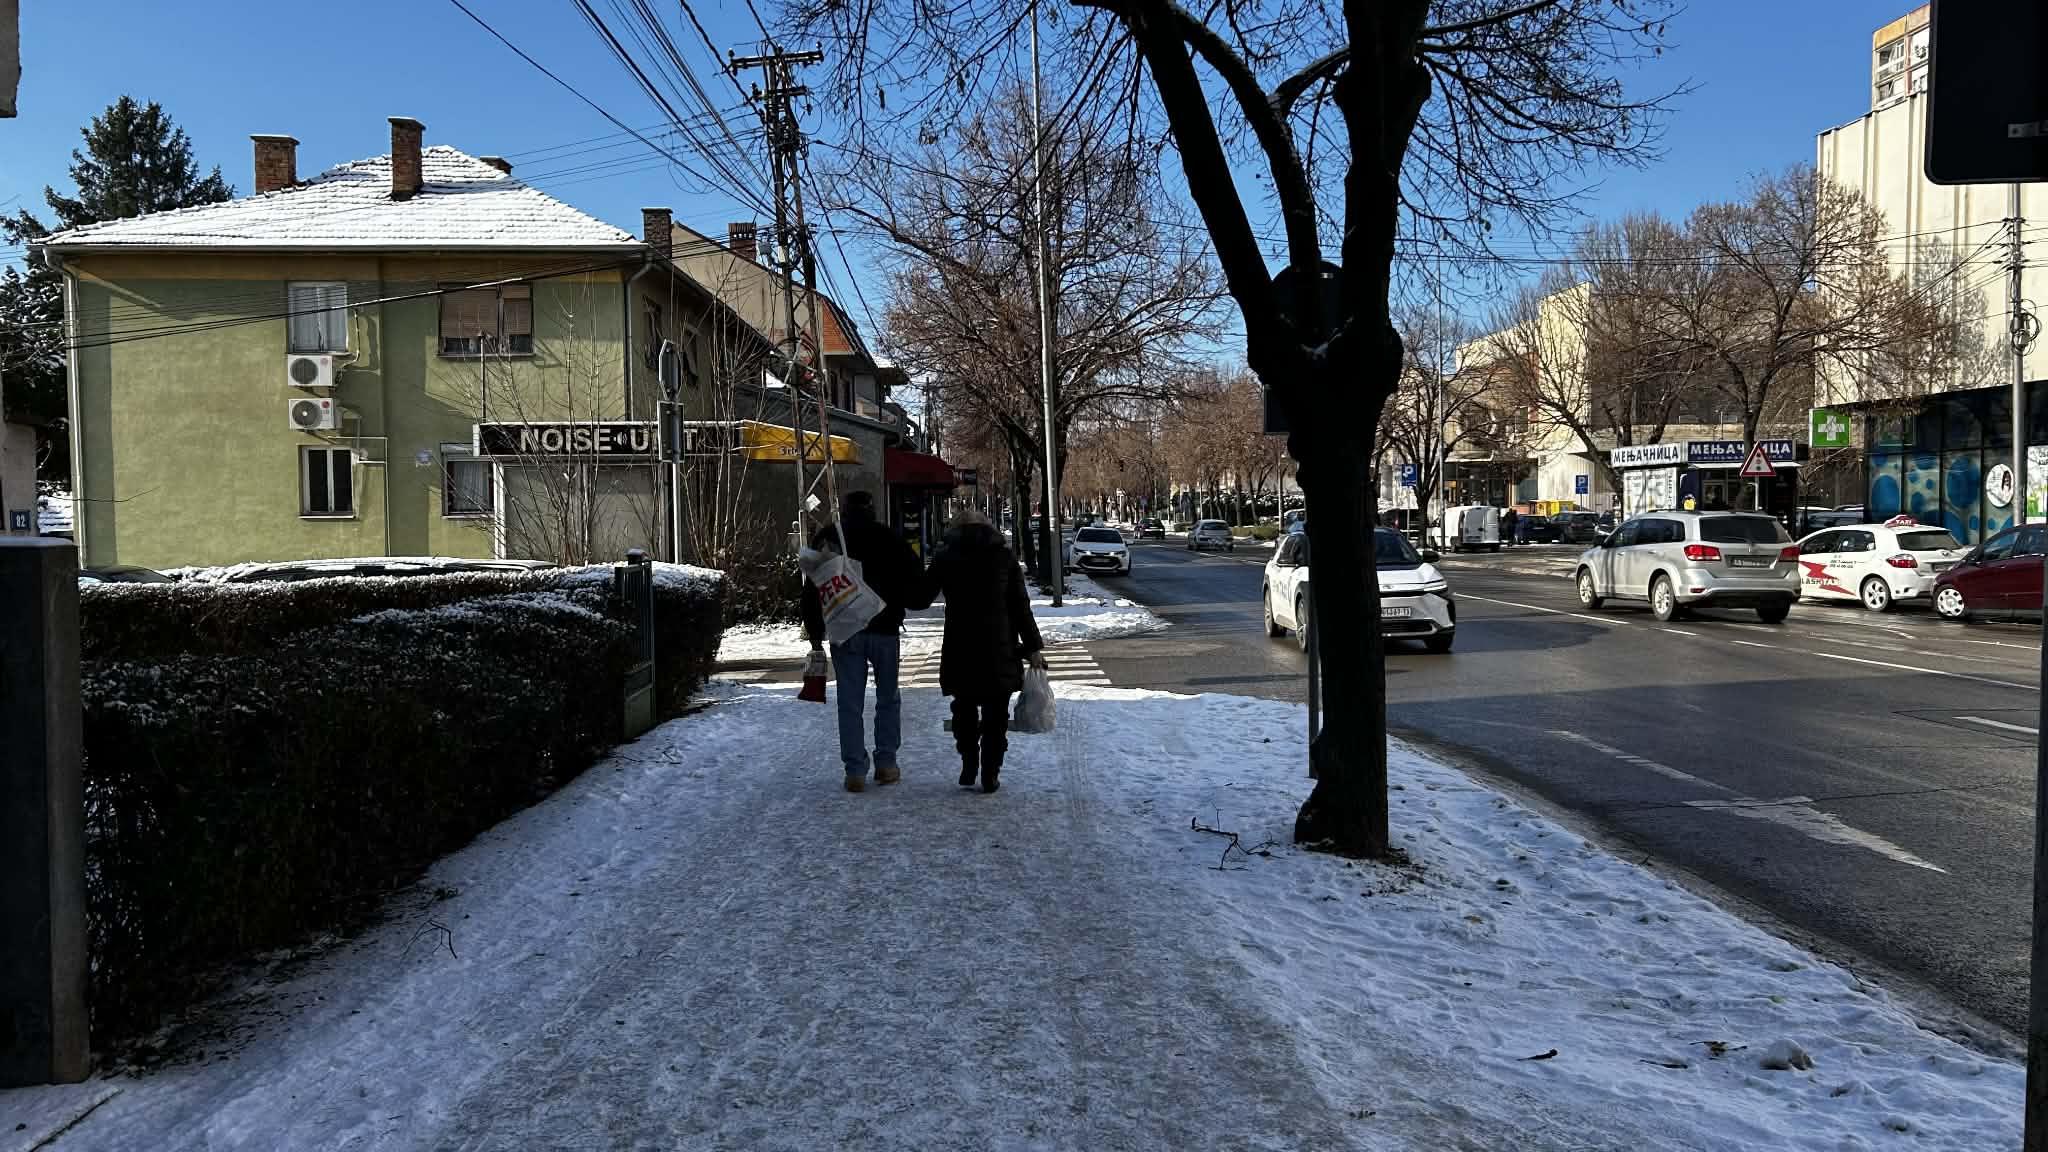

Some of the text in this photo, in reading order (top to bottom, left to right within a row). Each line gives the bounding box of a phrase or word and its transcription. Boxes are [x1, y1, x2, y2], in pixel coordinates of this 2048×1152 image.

[520, 428, 698, 451] NOISE UT
[1613, 446, 1679, 464] МЕЊАЧНИЦА
[1690, 442, 1791, 455] МЕЊАЧИЦА
[16, 515, 26, 527] 82
